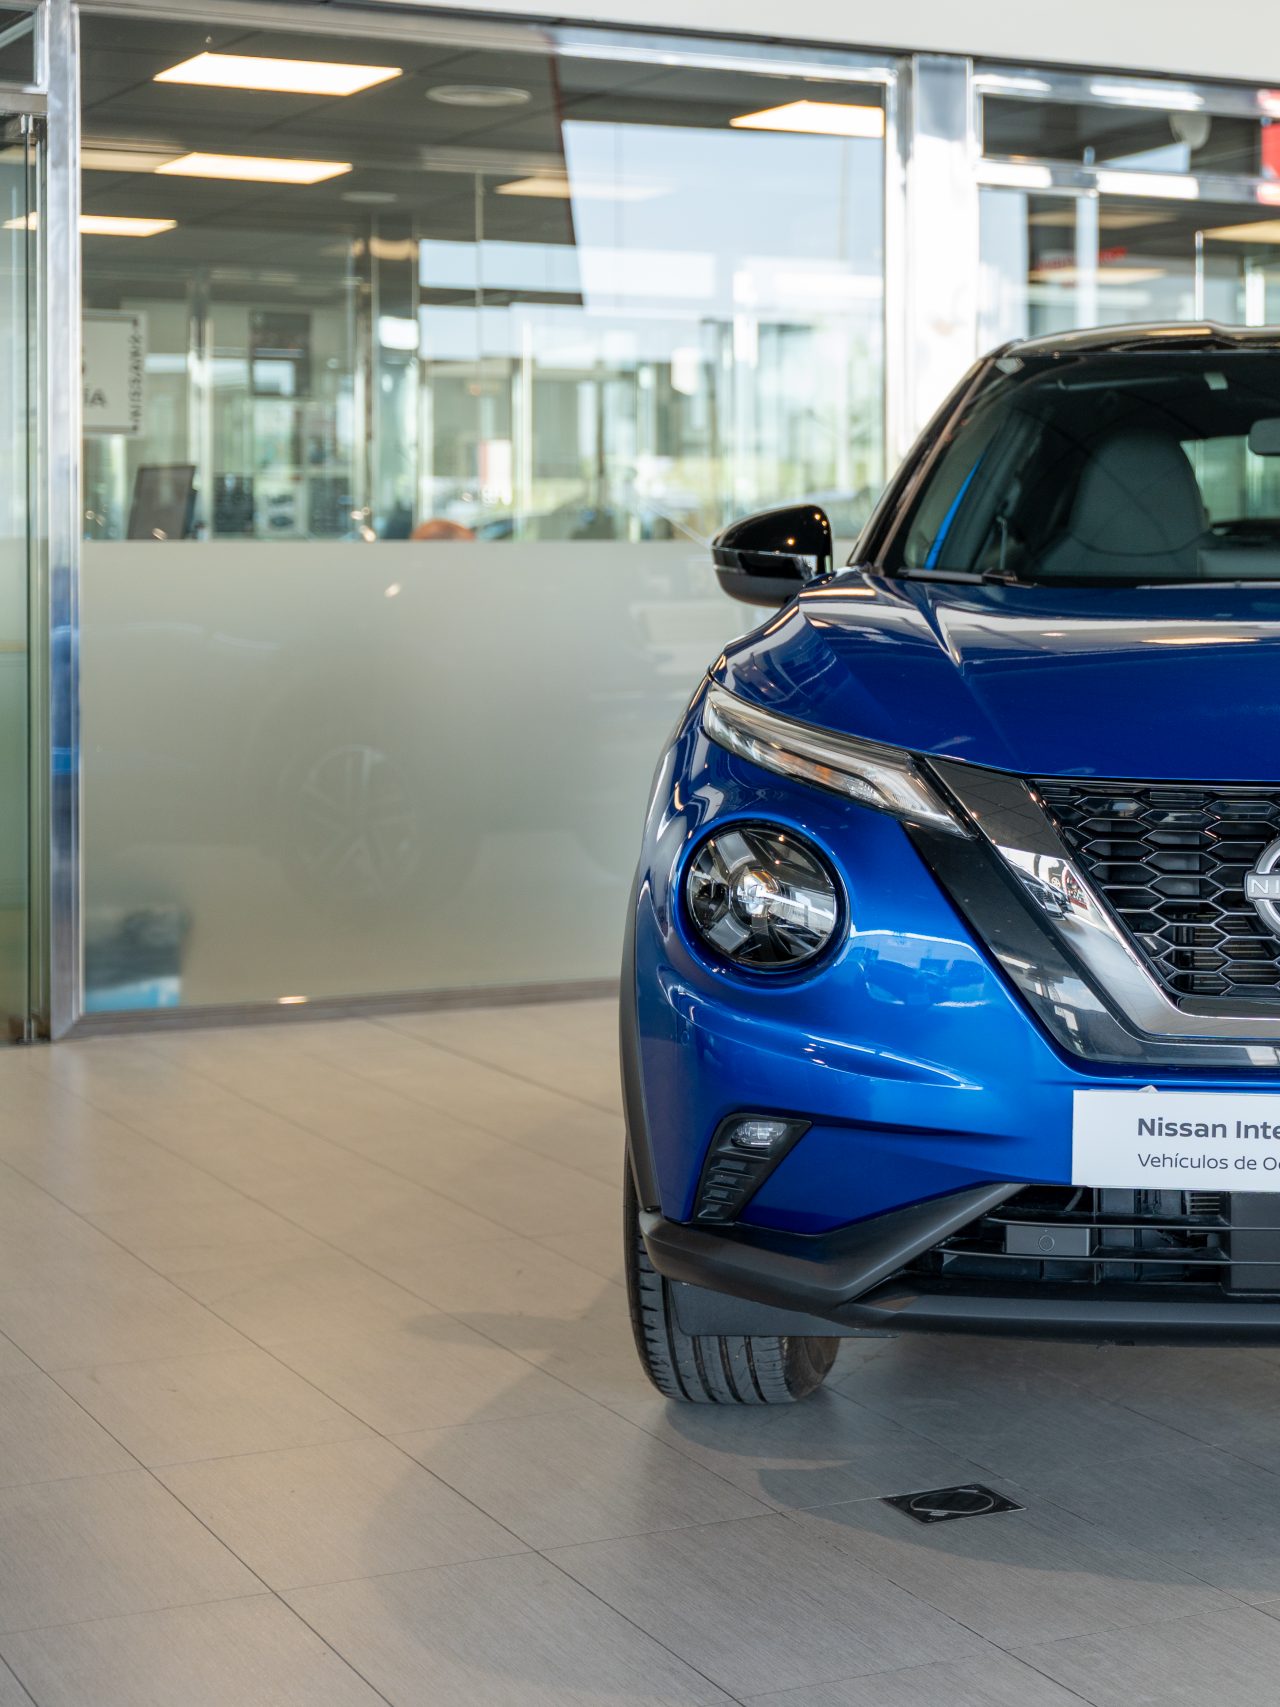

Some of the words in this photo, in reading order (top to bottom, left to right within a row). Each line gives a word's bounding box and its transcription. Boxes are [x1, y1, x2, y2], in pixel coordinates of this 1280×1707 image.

[1137, 1117, 1228, 1139] Nissan
[1137, 1152, 1229, 1171] Vehículos
[1234, 1154, 1257, 1171] de
